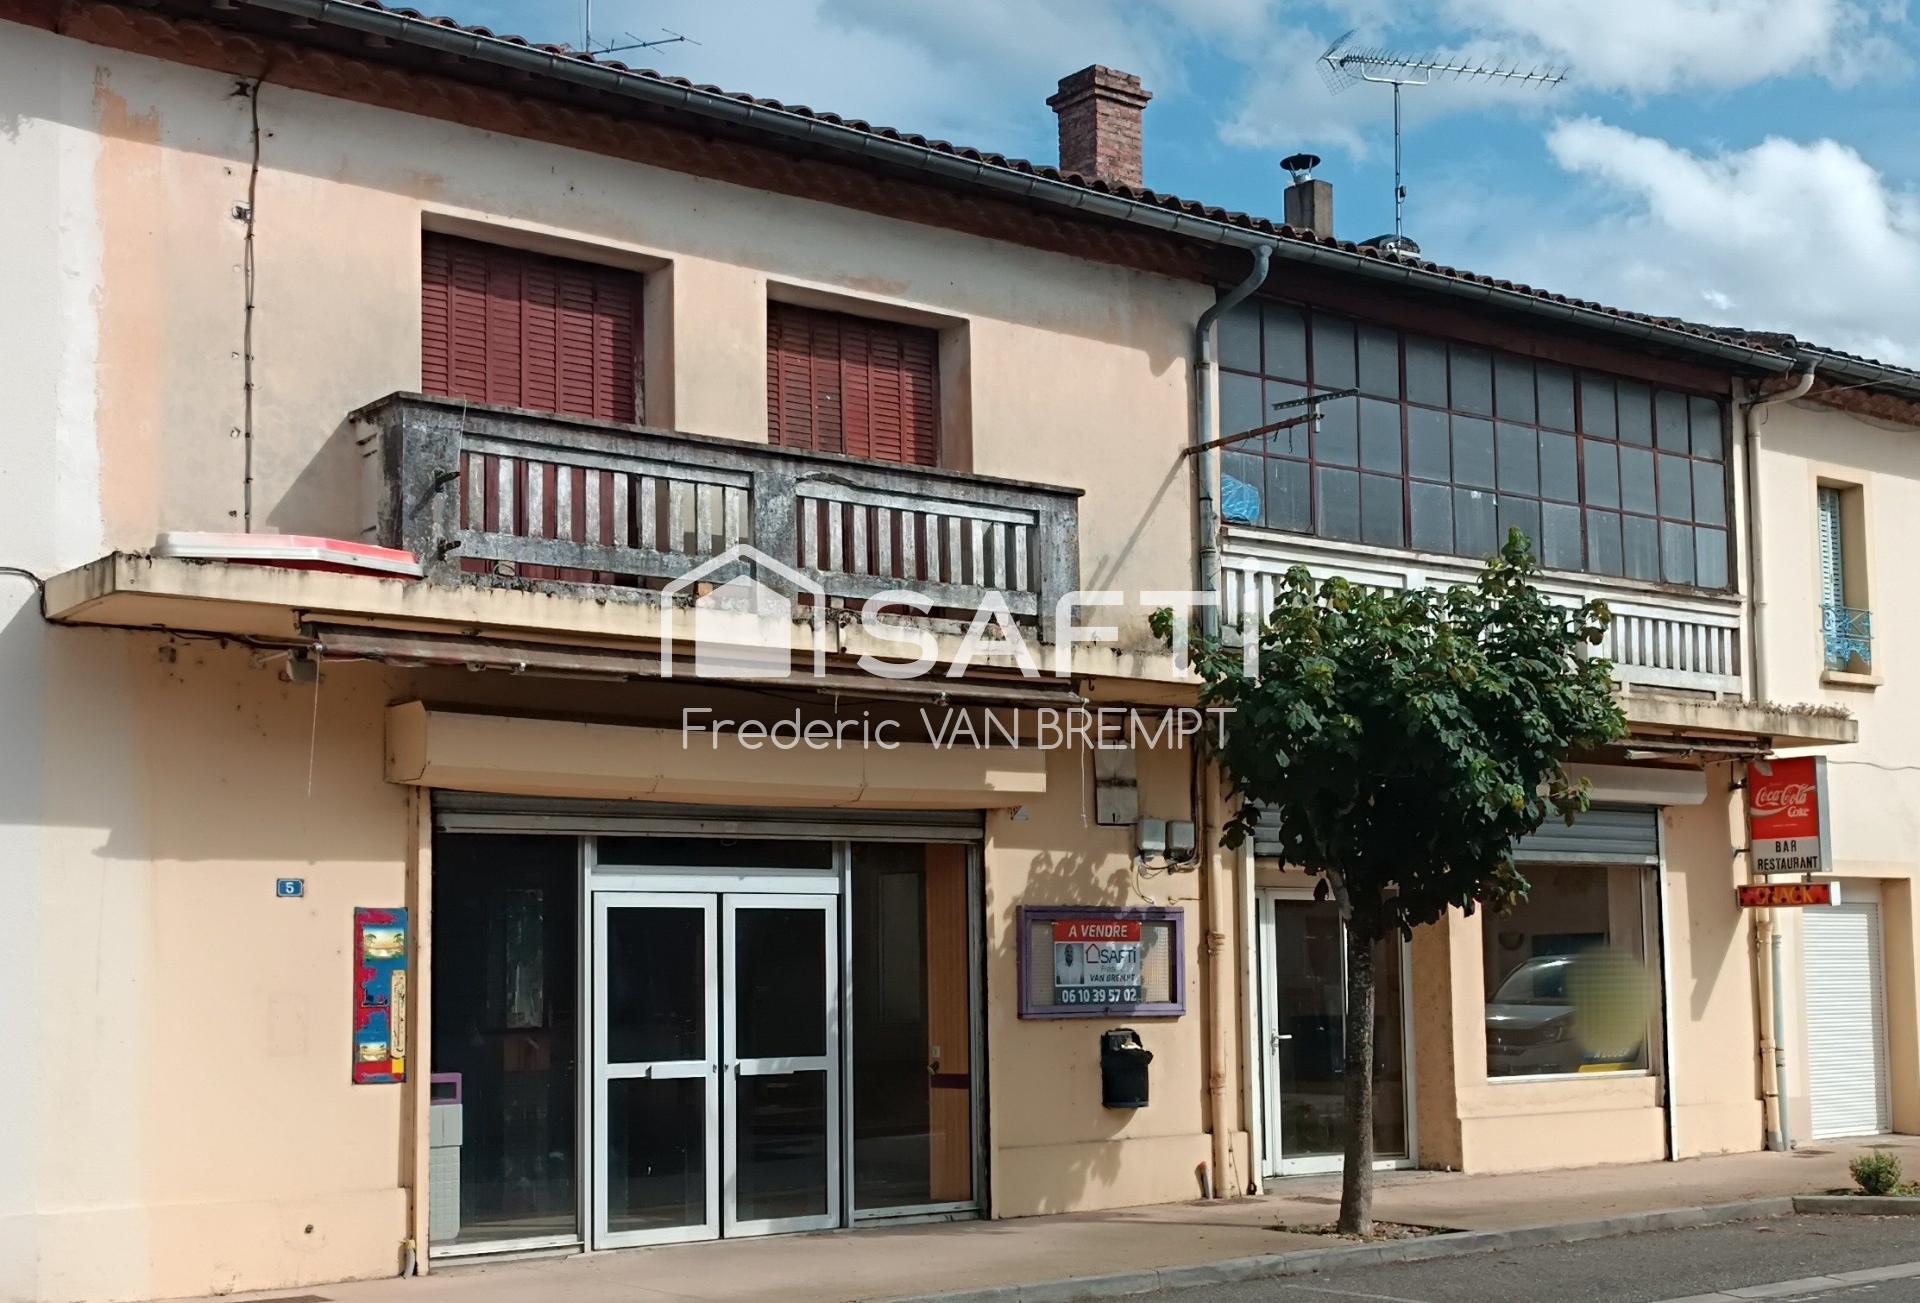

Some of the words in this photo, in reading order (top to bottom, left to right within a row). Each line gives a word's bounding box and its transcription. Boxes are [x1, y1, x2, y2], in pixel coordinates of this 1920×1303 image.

[1775, 840, 1797, 853] BAR
[1757, 856, 1818, 871] RESTAURANT
[286, 882, 294, 894] 5
[1070, 925, 1077, 938] A
[1081, 925, 1128, 938] VENDRE
[1090, 974, 1104, 982] VAN
[1062, 989, 1076, 1003] 06
[1078, 988, 1090, 1002] 10
[1092, 988, 1106, 1002] 39
[1108, 988, 1120, 1002] 57
[1123, 987, 1137, 1001] 02
